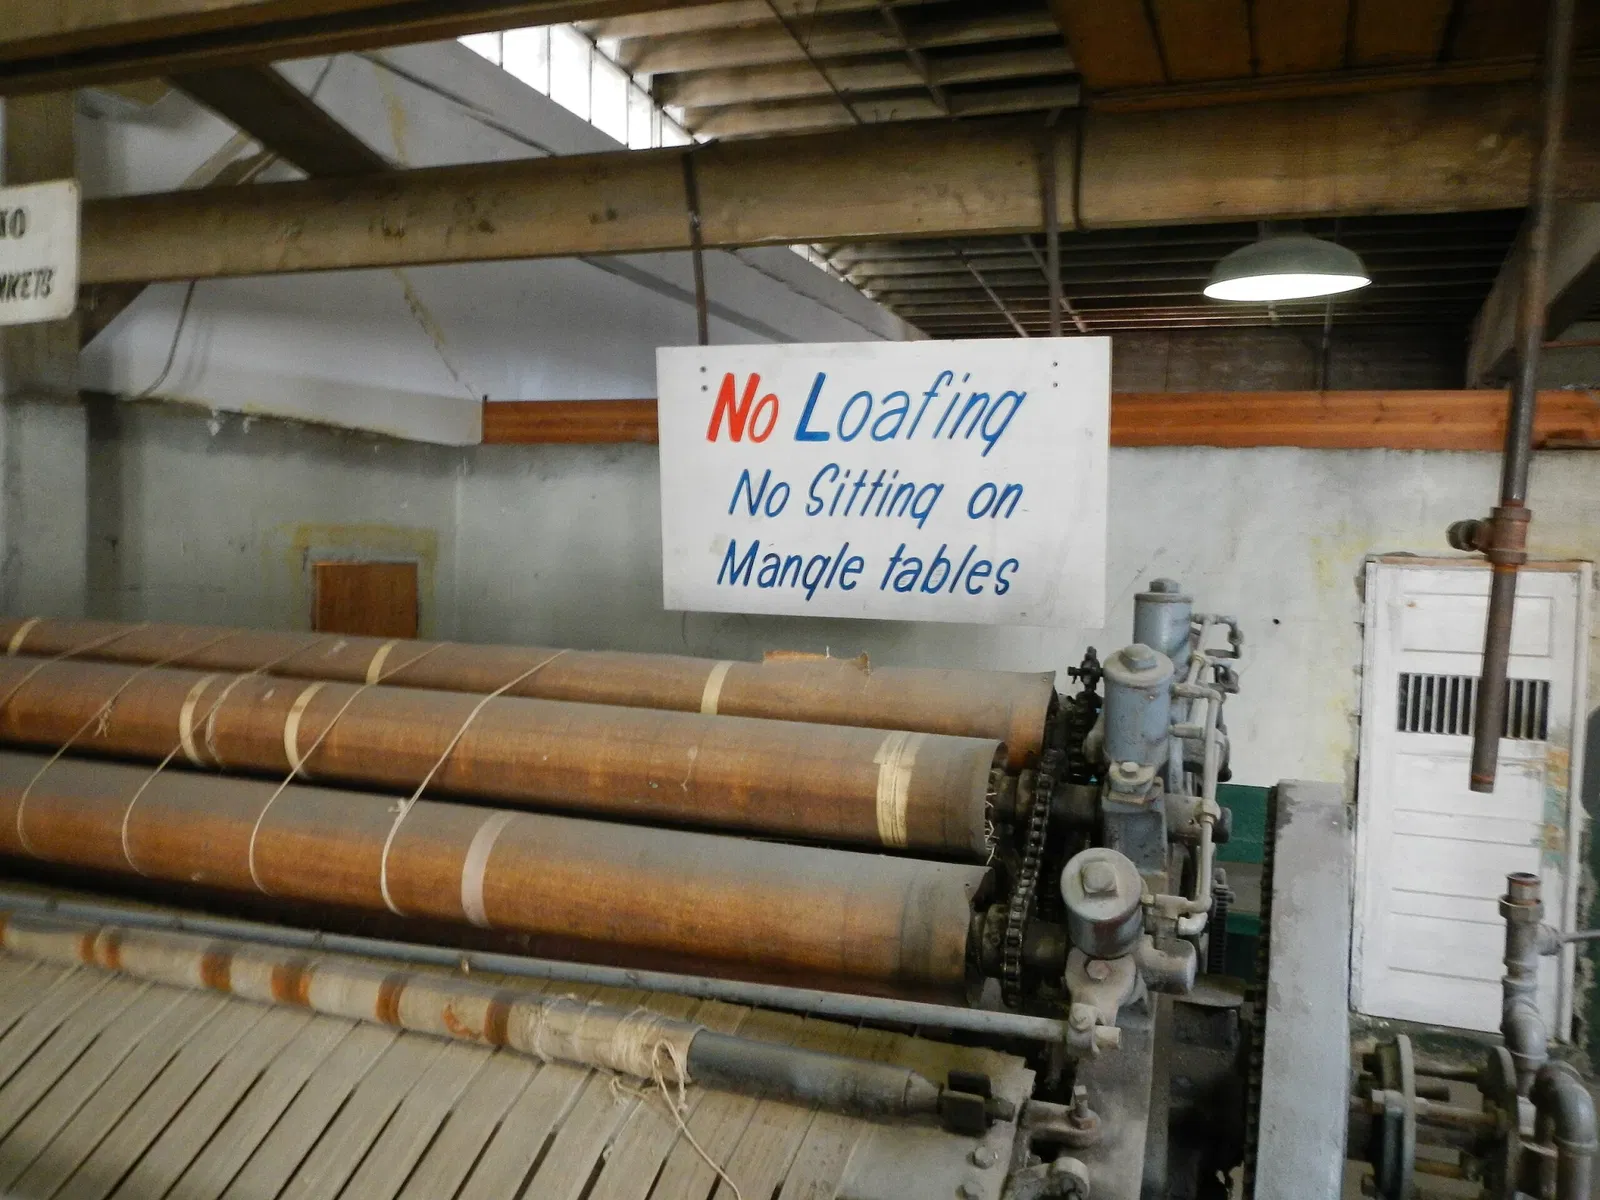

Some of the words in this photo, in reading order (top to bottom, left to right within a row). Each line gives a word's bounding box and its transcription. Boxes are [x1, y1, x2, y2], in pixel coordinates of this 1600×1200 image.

[706, 372, 780, 444] No
[794, 369, 1027, 457] Loafing
[728, 468, 790, 518] No
[805, 462, 944, 530] Sitting
[967, 481, 1023, 519] on
[717, 538, 864, 602] Mangle
[880, 542, 1019, 596] tables
